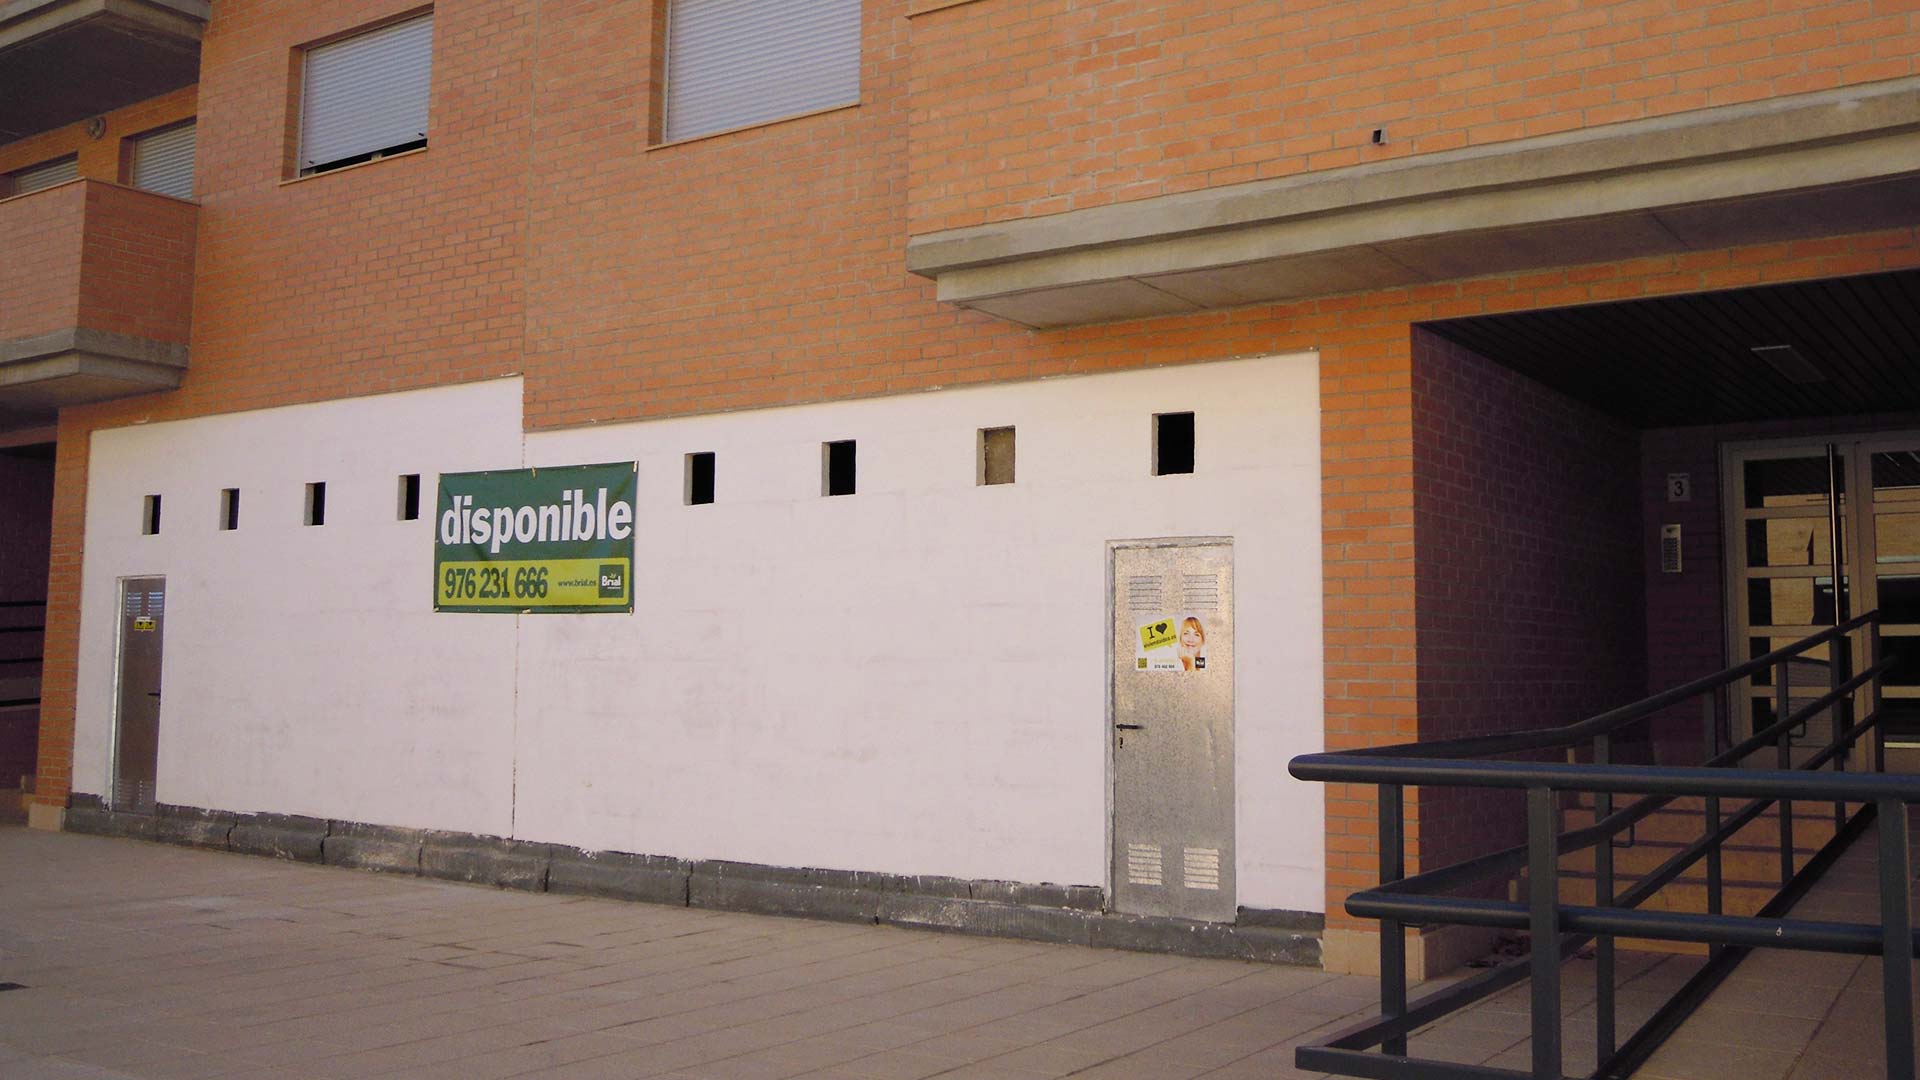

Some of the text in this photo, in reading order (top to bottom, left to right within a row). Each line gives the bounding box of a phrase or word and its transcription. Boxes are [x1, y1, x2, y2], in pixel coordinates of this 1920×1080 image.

[1674, 480, 1684, 497] 3
[441, 488, 632, 554] disponible
[445, 566, 549, 599] 976 231 666
[601, 575, 622, 587] Brial
[1147, 625, 1155, 640] I
